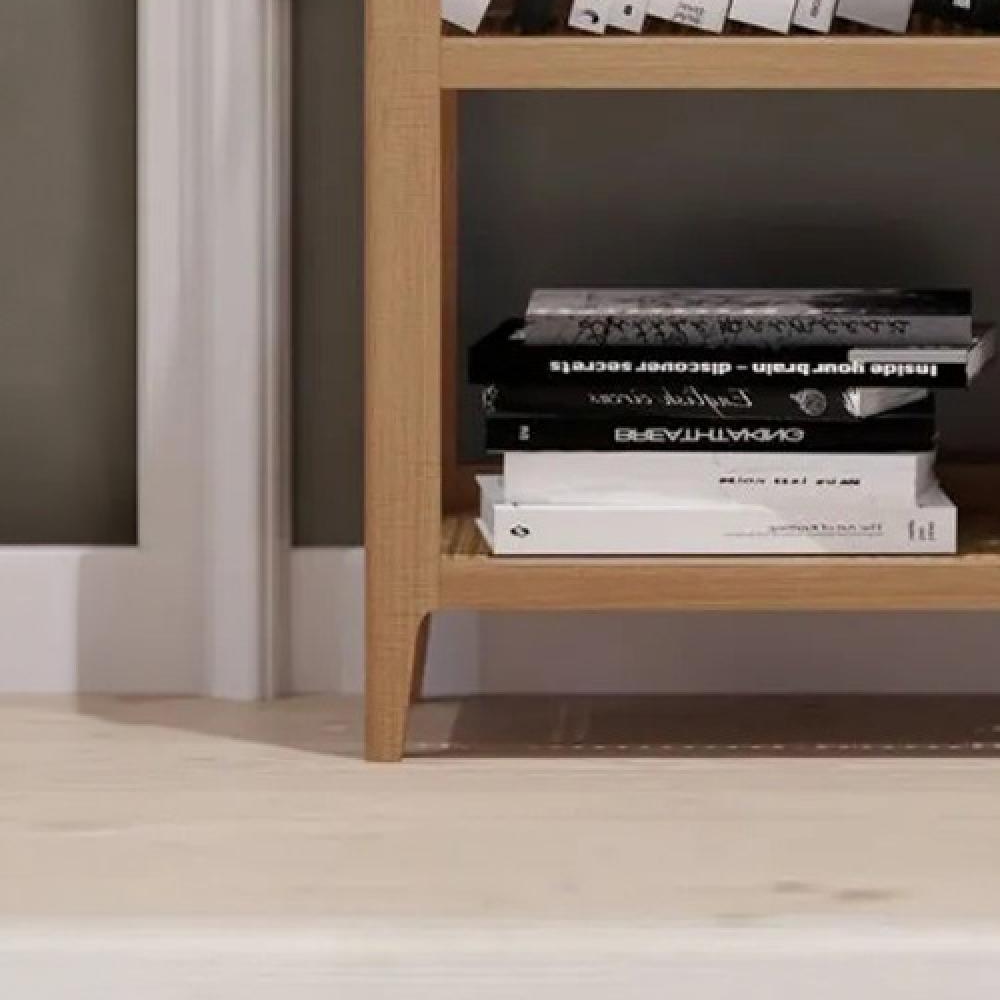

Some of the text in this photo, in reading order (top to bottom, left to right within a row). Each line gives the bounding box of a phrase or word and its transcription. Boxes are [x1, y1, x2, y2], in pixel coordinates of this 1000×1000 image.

[549, 361, 633, 375] secrets
[635, 361, 733, 375] discover
[751, 363, 811, 377] brain
[811, 359, 867, 375] your
[869, 360, 940, 377] Inside
